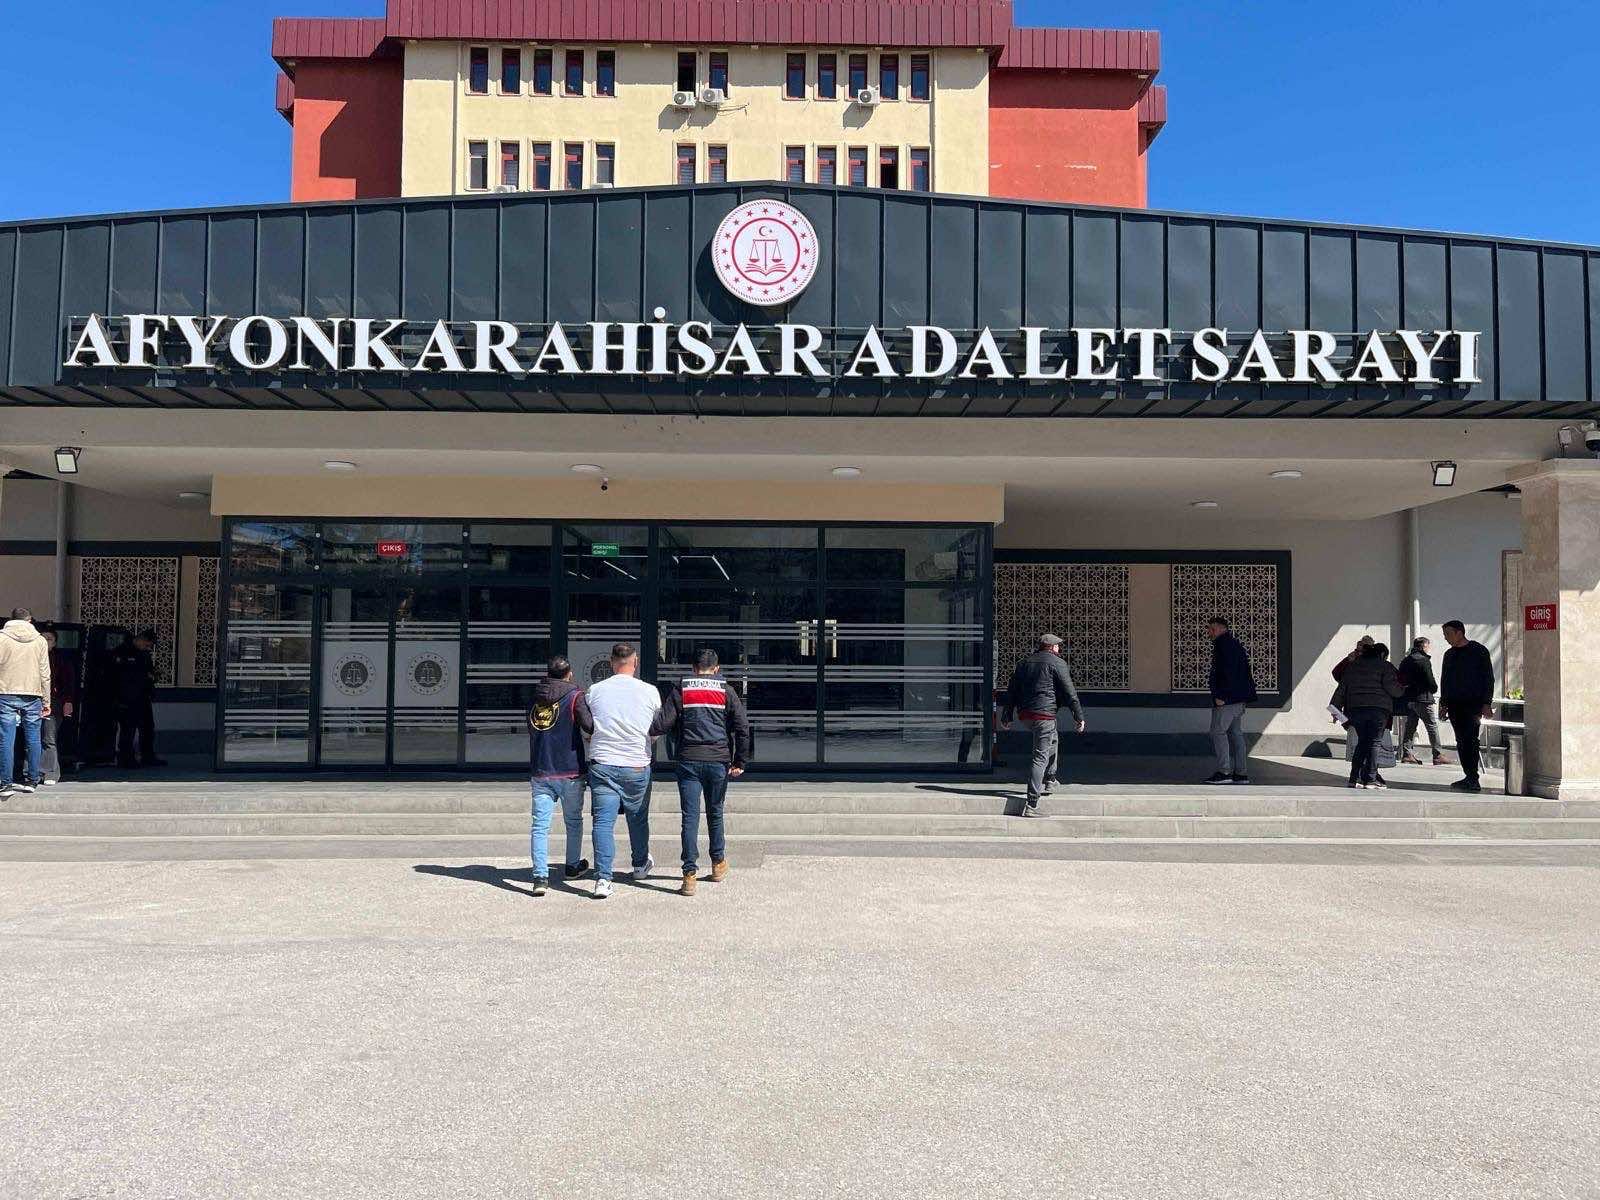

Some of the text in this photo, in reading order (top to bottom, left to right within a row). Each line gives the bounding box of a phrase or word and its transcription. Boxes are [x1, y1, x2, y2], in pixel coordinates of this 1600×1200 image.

[63, 307, 1483, 387] AFYONKARAHİSAR ADALET SARAYI
[1530, 606, 1551, 622] GİRİŞ
